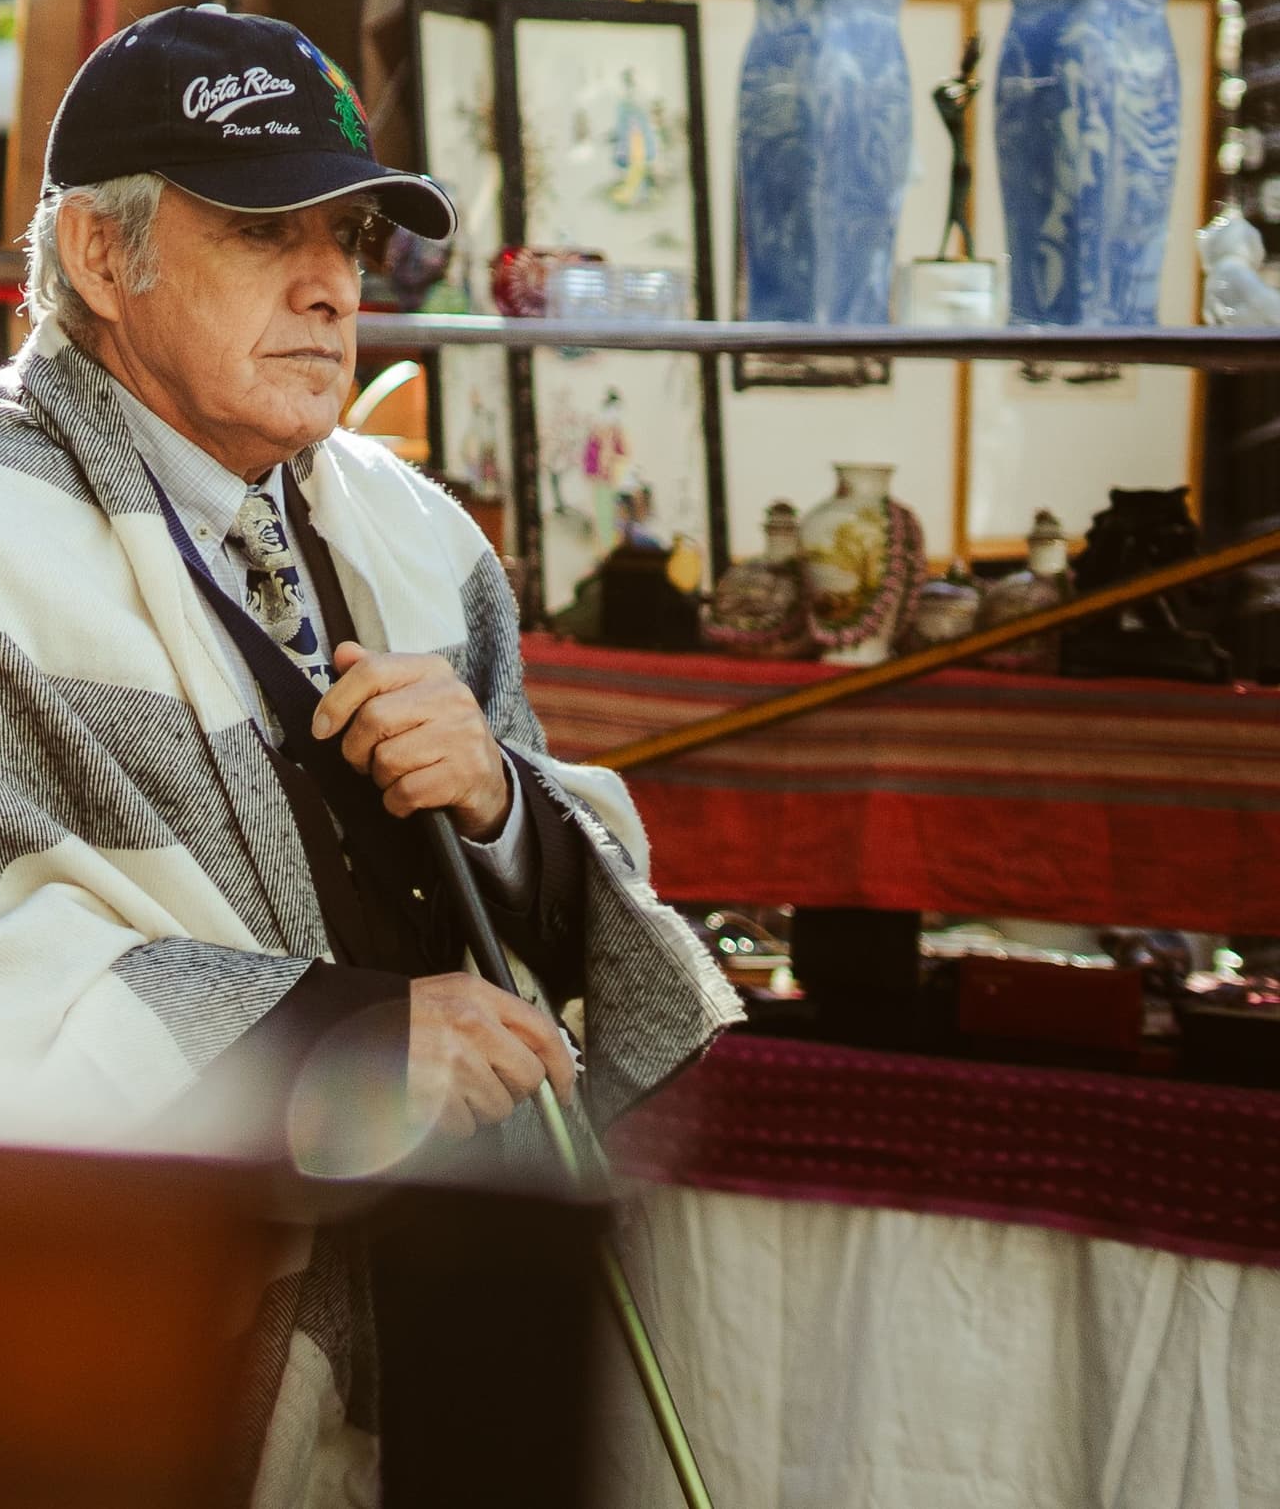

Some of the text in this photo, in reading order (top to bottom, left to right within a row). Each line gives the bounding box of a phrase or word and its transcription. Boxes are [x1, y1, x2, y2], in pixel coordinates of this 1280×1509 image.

[182, 66, 296, 120] Costa Rica
[221, 120, 302, 139] Pura Vida
